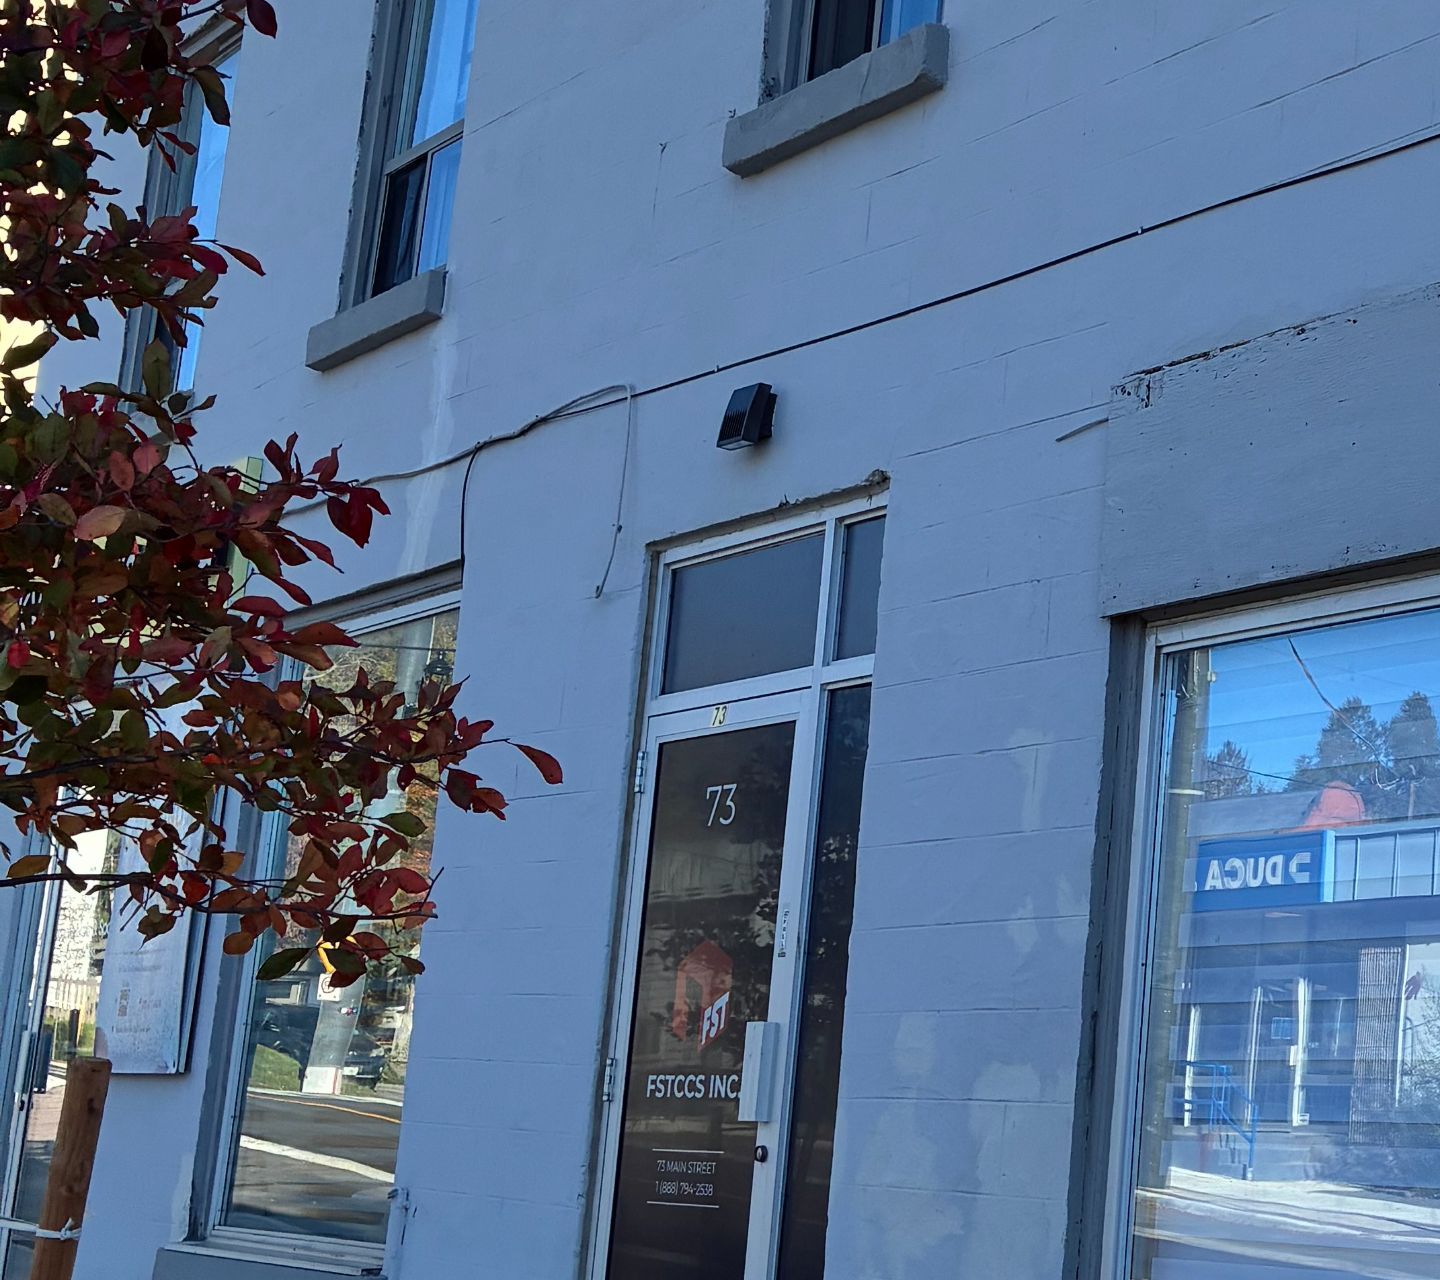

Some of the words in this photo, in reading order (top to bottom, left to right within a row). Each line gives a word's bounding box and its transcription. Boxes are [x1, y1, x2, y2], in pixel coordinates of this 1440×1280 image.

[712, 705, 727, 726] 73
[706, 783, 737, 827] 73
[701, 991, 730, 1046] FST
[646, 1074, 705, 1098] FSTCCS
[656, 1160, 666, 1172] 73
[667, 1161, 687, 1173] MAIN
[688, 1162, 716, 1174] STREET
